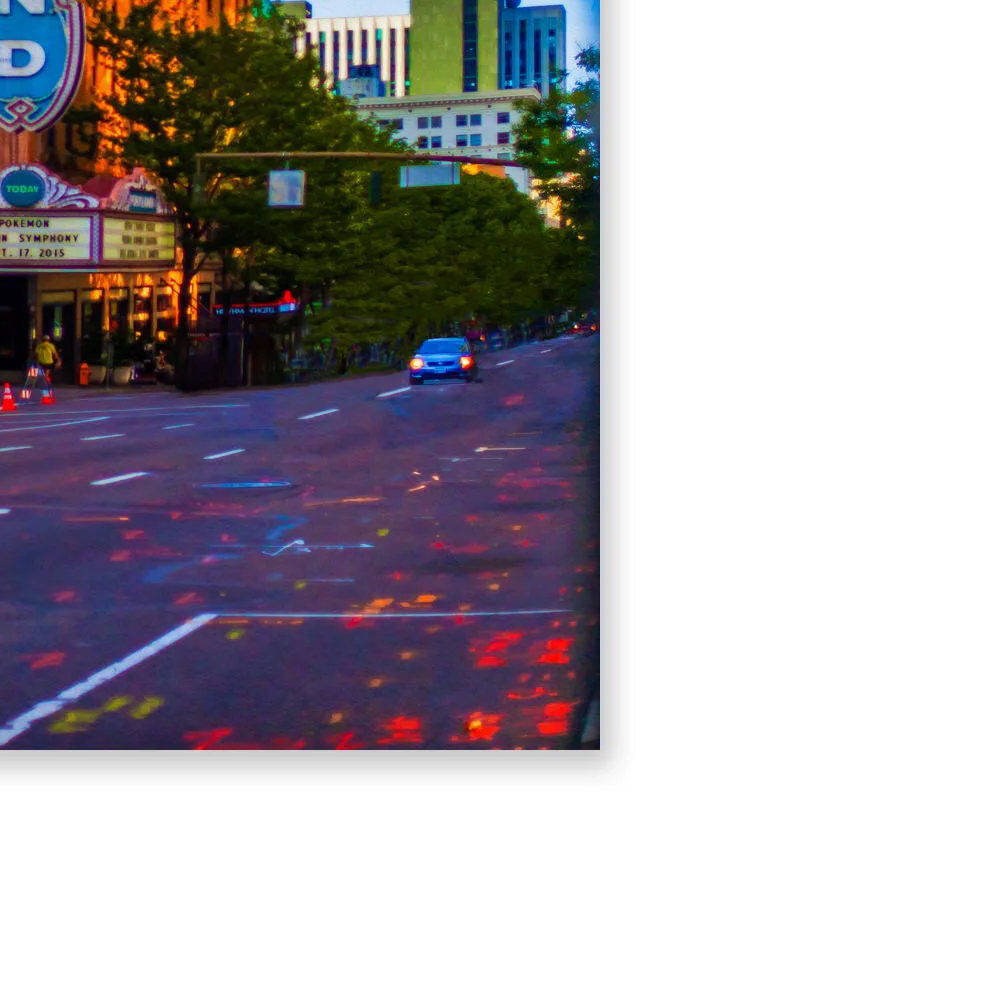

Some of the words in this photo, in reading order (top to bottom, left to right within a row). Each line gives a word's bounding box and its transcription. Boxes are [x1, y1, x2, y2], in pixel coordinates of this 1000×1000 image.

[6, 184, 39, 194] TODAY
[19, 233, 79, 244] SYMPHONY
[39, 248, 65, 258] 2015
